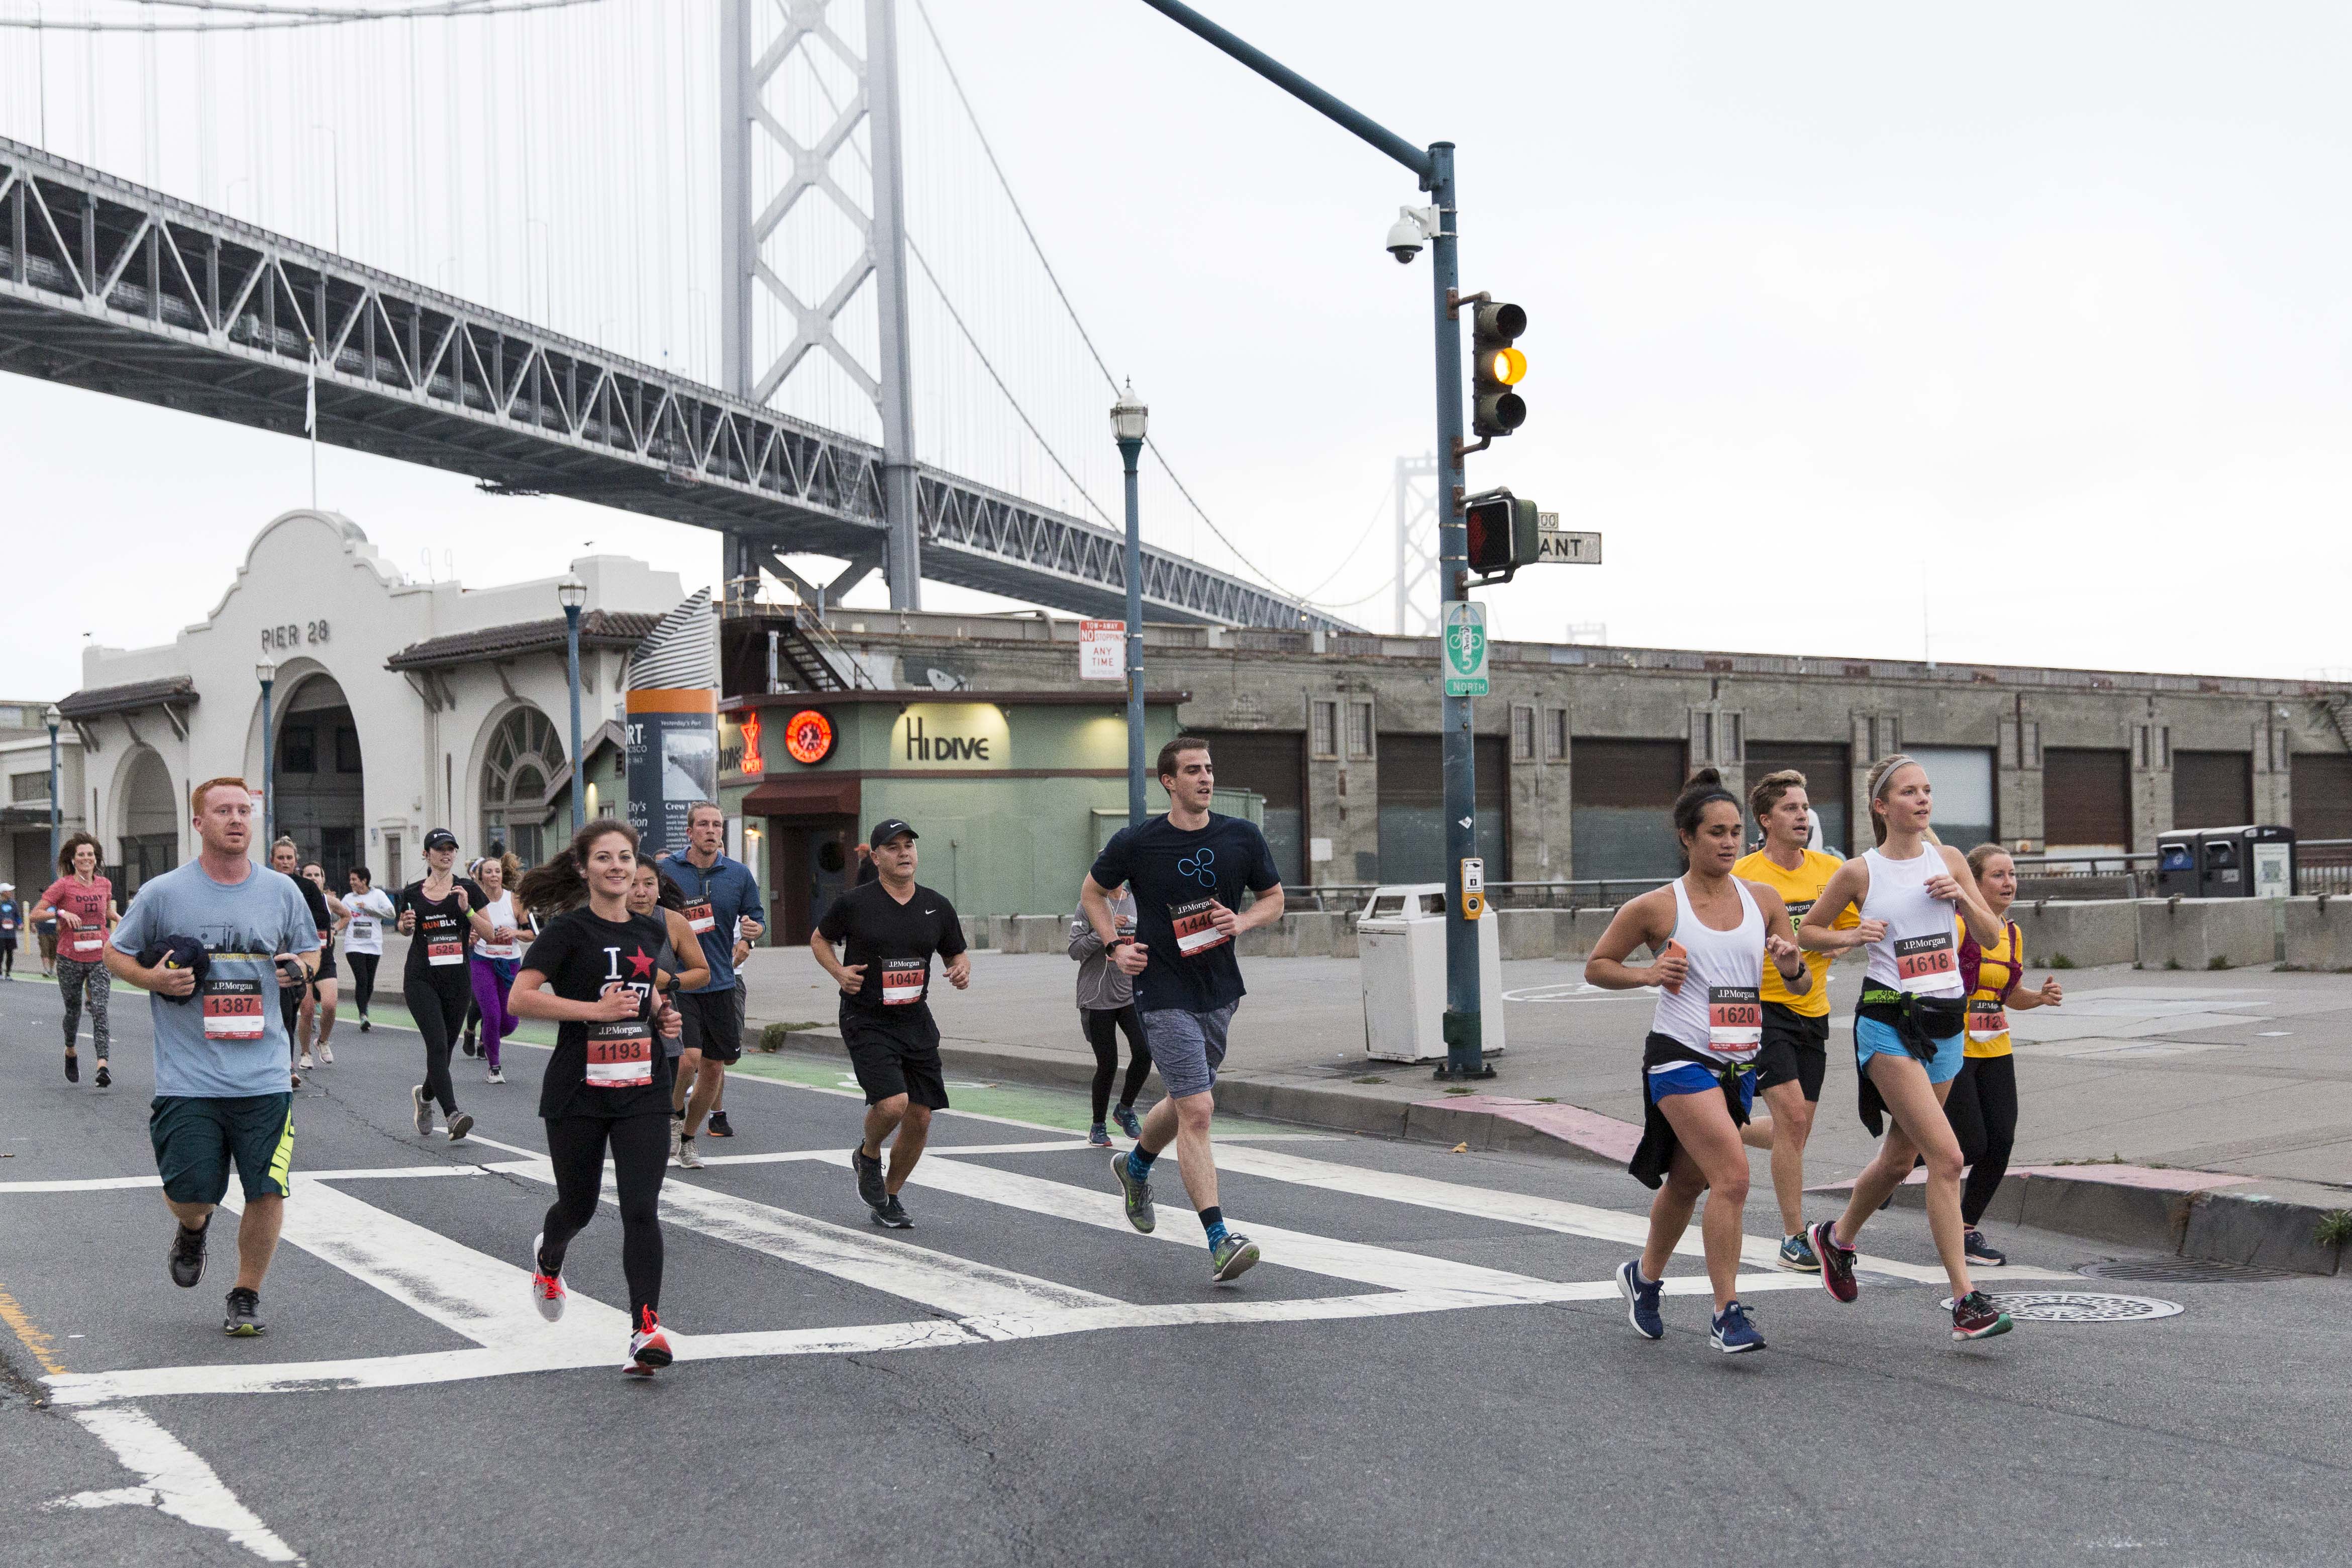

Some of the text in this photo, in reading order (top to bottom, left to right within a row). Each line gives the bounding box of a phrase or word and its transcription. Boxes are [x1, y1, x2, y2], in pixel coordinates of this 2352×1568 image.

[1541, 515, 1556, 526] 00
[1540, 538, 1581, 556] ANT
[262, 620, 328, 649] PIER 28
[1081, 630, 1124, 642] NO STOPPING
[1093, 647, 1112, 655] ANY
[1092, 658, 1114, 667] TIME
[1463, 654, 1472, 670] 5
[1453, 681, 1485, 692] NORTH
[935, 737, 989, 760] DIVE
[742, 759, 761, 773] OPEN
[665, 802, 685, 810] Crew
[1178, 900, 1211, 914] J.P.Morga
[436, 945, 454, 954] 525
[1904, 937, 1946, 950] J.P.Morgan
[604, 948, 622, 979] I
[1906, 953, 1949, 974] 1618
[888, 972, 918, 985] 1047
[213, 982, 253, 992] J.P.Morgan
[1718, 990, 1755, 1000] J.P.Morgan
[212, 998, 253, 1013] 1387
[1717, 1007, 1755, 1023] 1620
[599, 1026, 643, 1035] J.P.Morgan
[598, 1042, 641, 1060] 1193
